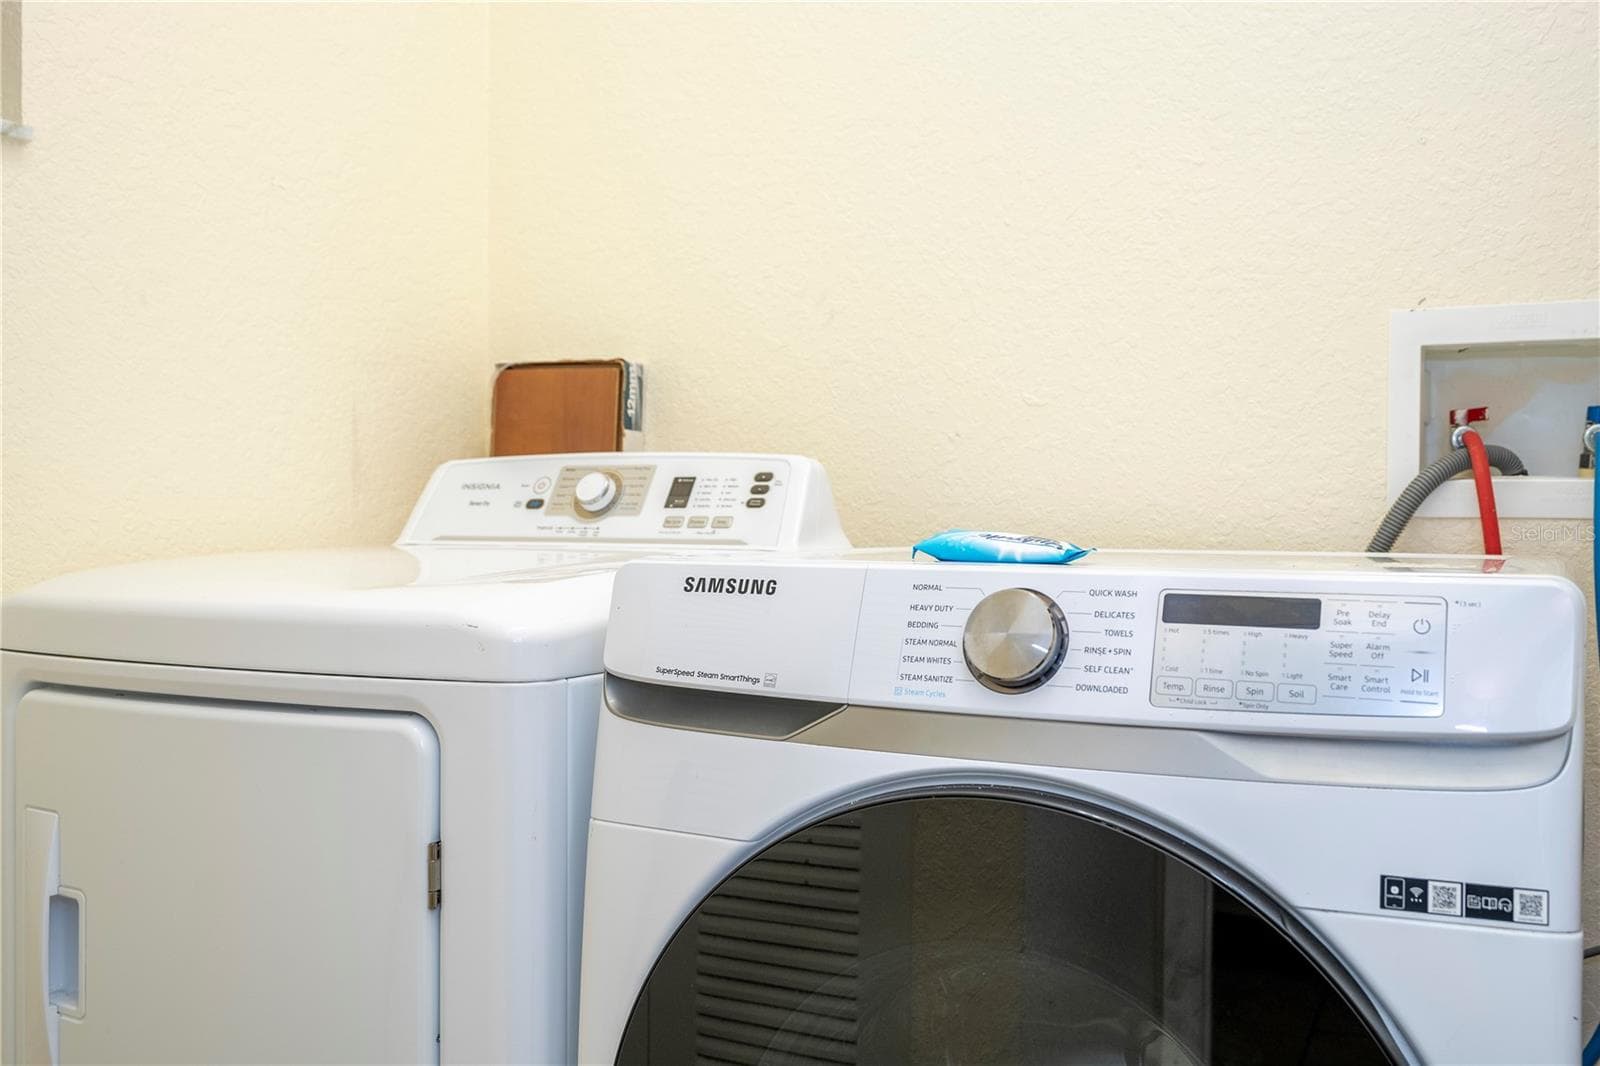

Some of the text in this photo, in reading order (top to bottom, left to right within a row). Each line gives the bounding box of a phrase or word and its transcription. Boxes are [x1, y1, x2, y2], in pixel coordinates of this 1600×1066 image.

[683, 576, 777, 596] SAMSUNG
[912, 583, 943, 592] NORMAL
[1088, 588, 1138, 598] QUICK WASH
[909, 604, 954, 613] HEAVY DUTY
[1336, 609, 1350, 617] Pre
[1094, 610, 1136, 620] DELICATES
[1368, 611, 1391, 620] Delay
[907, 620, 939, 629] BEDDING
[1333, 618, 1352, 626] Soak
[1372, 620, 1387, 628] End
[1104, 628, 1134, 638] TOWELS
[904, 638, 958, 648] STEAM NORMAL
[1330, 641, 1352, 651] Super
[1366, 643, 1390, 651] Alarm
[1084, 646, 1108, 655] RINSE
[1113, 647, 1132, 656] SPIN
[1329, 650, 1353, 659] Speed
[1371, 652, 1384, 660] Off
[902, 655, 952, 665] STEAM WHITES
[1083, 664, 1102, 674] SELF
[655, 665, 761, 686] SuperSpeed Steam SmartThings
[900, 673, 953, 684] STEAM SANITIZE
[1328, 673, 1352, 683] Smart
[1364, 675, 1389, 684] Smart
[1075, 683, 1129, 695] DOWNLOADED
[1203, 684, 1225, 694] Rinse
[1246, 687, 1264, 697] Spin
[1330, 683, 1349, 691] Care
[1361, 685, 1391, 694] Control
[925, 689, 946, 699] Cycles
[1288, 689, 1305, 699] Soil
